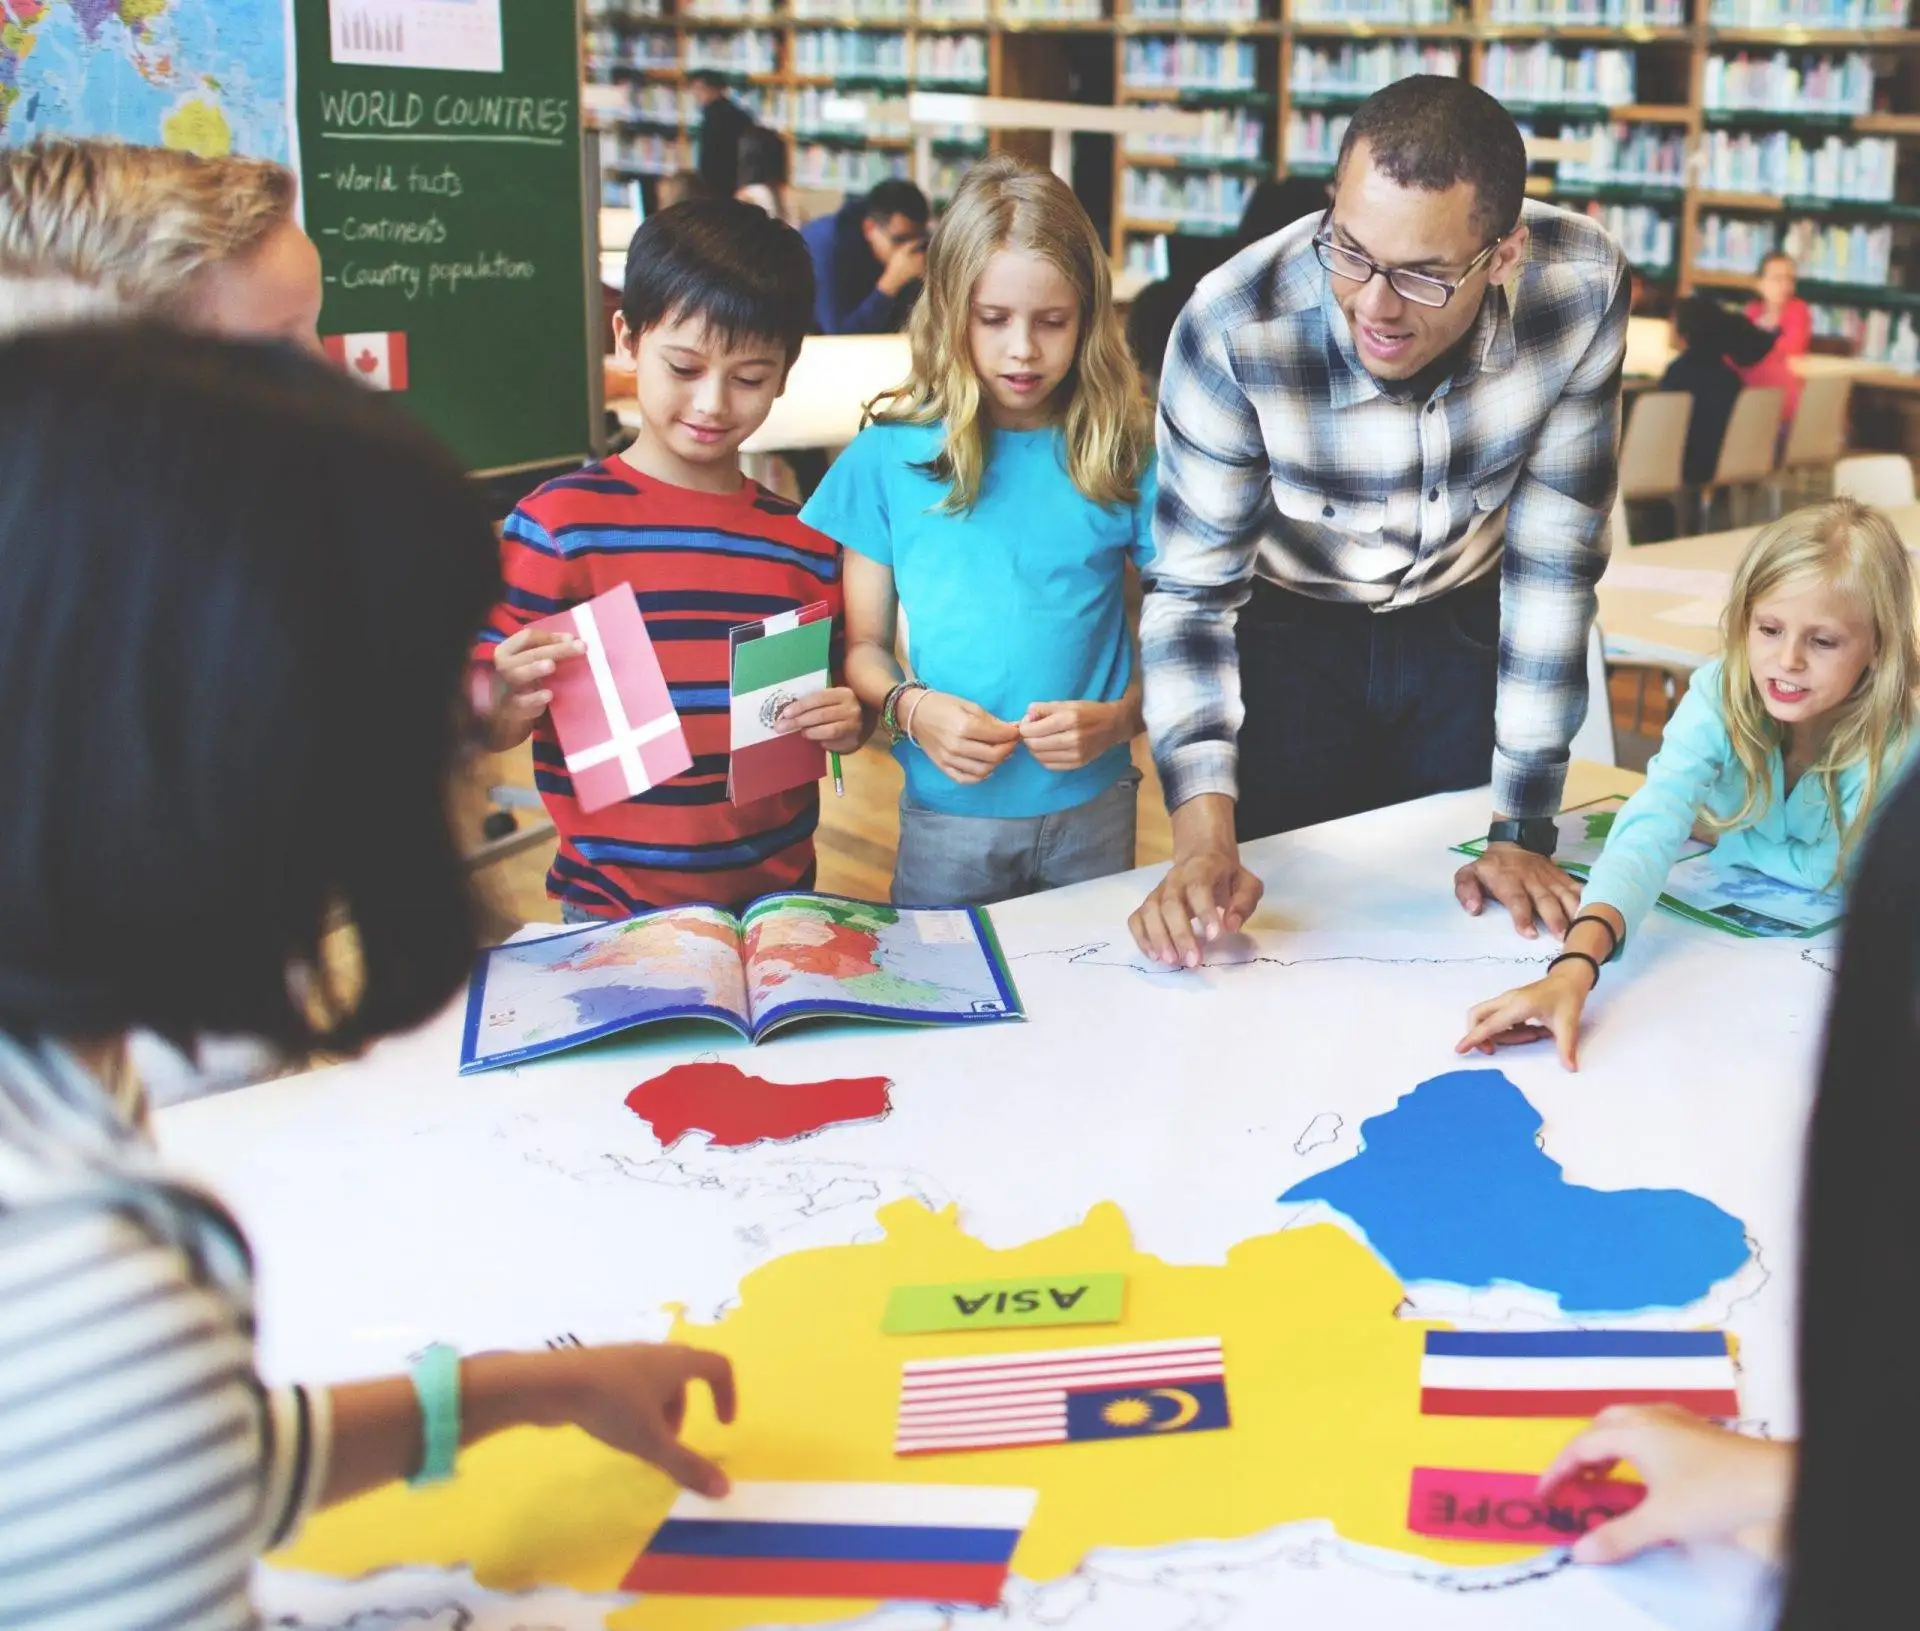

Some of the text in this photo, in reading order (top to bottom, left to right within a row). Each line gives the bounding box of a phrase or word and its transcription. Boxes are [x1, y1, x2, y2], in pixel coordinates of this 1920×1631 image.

[320, 90, 568, 135] WORLD COUNTRIES
[409, 164, 463, 197] facts
[953, 1286, 1089, 1316] ASIA
[1427, 1490, 1616, 1533] UROPE
